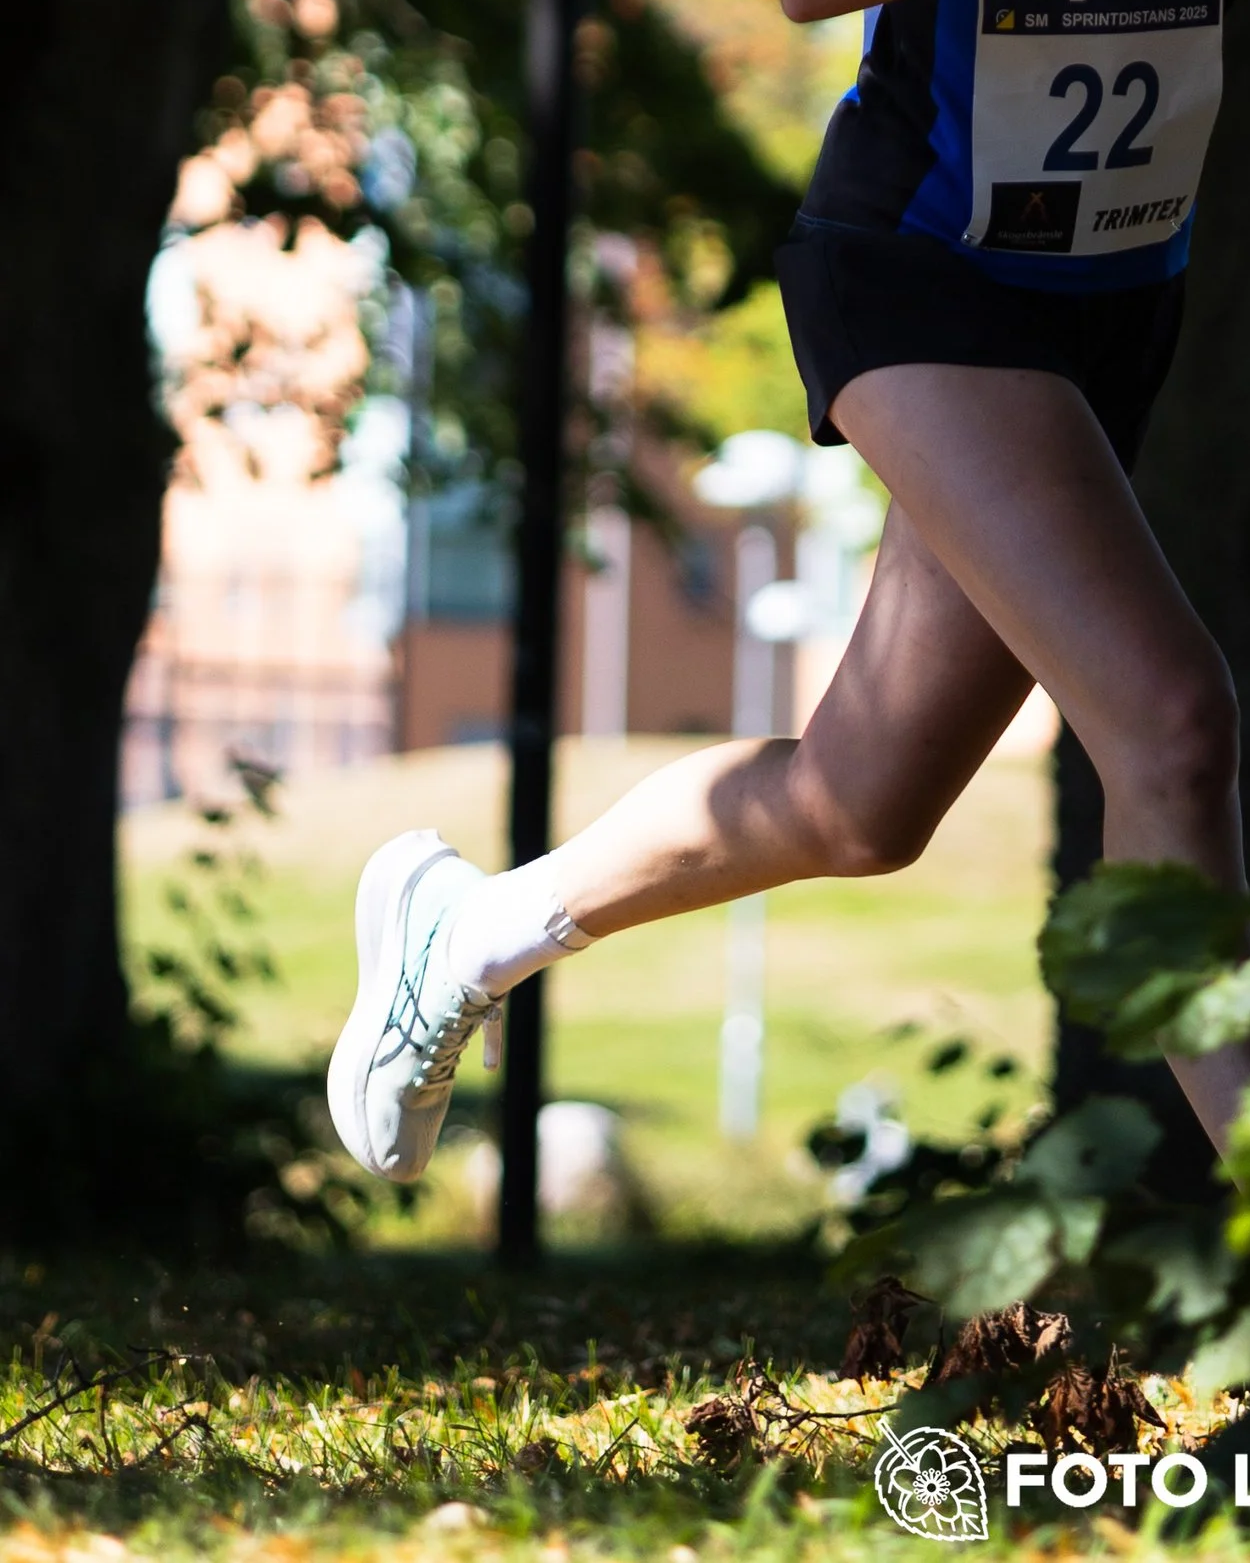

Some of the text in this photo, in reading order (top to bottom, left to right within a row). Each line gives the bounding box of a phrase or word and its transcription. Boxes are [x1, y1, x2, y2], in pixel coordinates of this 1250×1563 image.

[1025, 5, 1208, 28] SM SPRINTDISTANS 2025
[1042, 61, 1160, 171] 22
[1092, 195, 1188, 232] TRIMTEX
